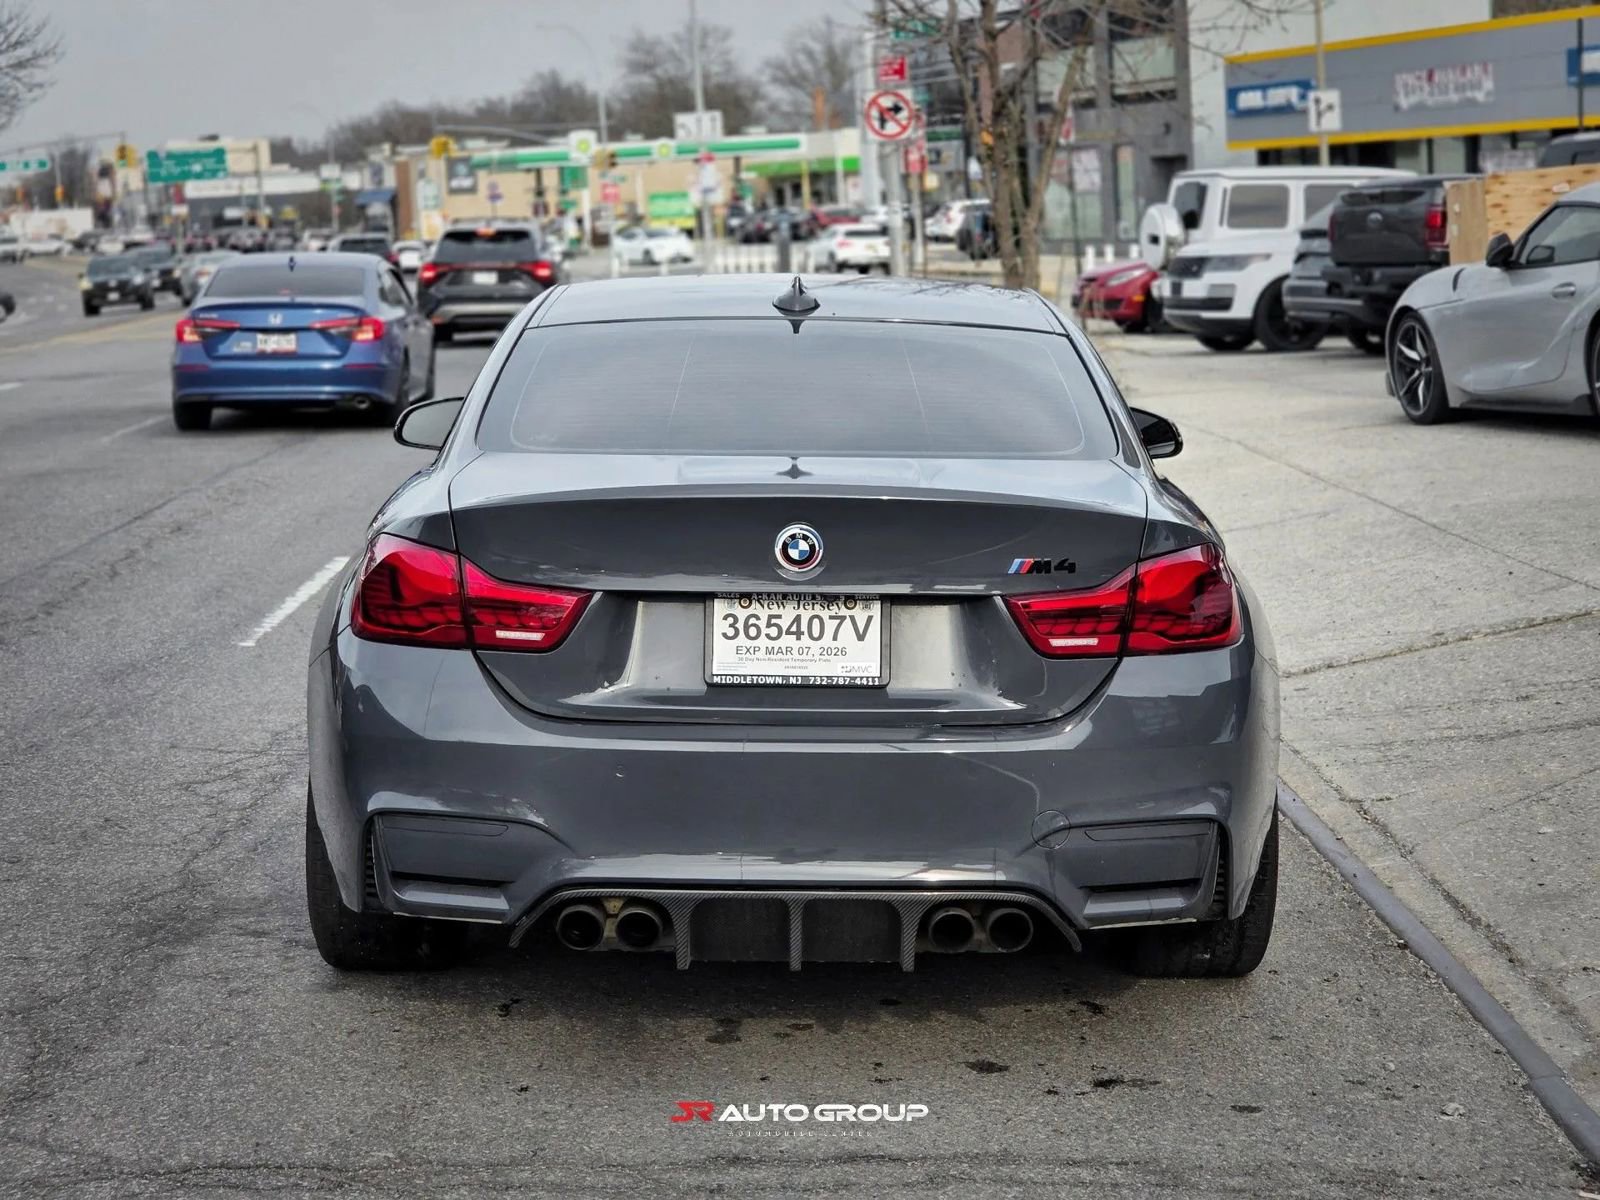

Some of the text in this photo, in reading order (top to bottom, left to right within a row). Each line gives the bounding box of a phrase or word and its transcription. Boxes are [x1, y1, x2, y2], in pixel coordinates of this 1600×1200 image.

[784, 533, 815, 546] BMW
[1026, 558, 1076, 574] M4
[752, 599, 843, 614] New Jersey
[721, 613, 874, 641] 365407V
[736, 646, 848, 657] EXP MAR 07, 2026
[713, 675, 880, 685] MIDDLETOWN, NJ 732-787-4411
